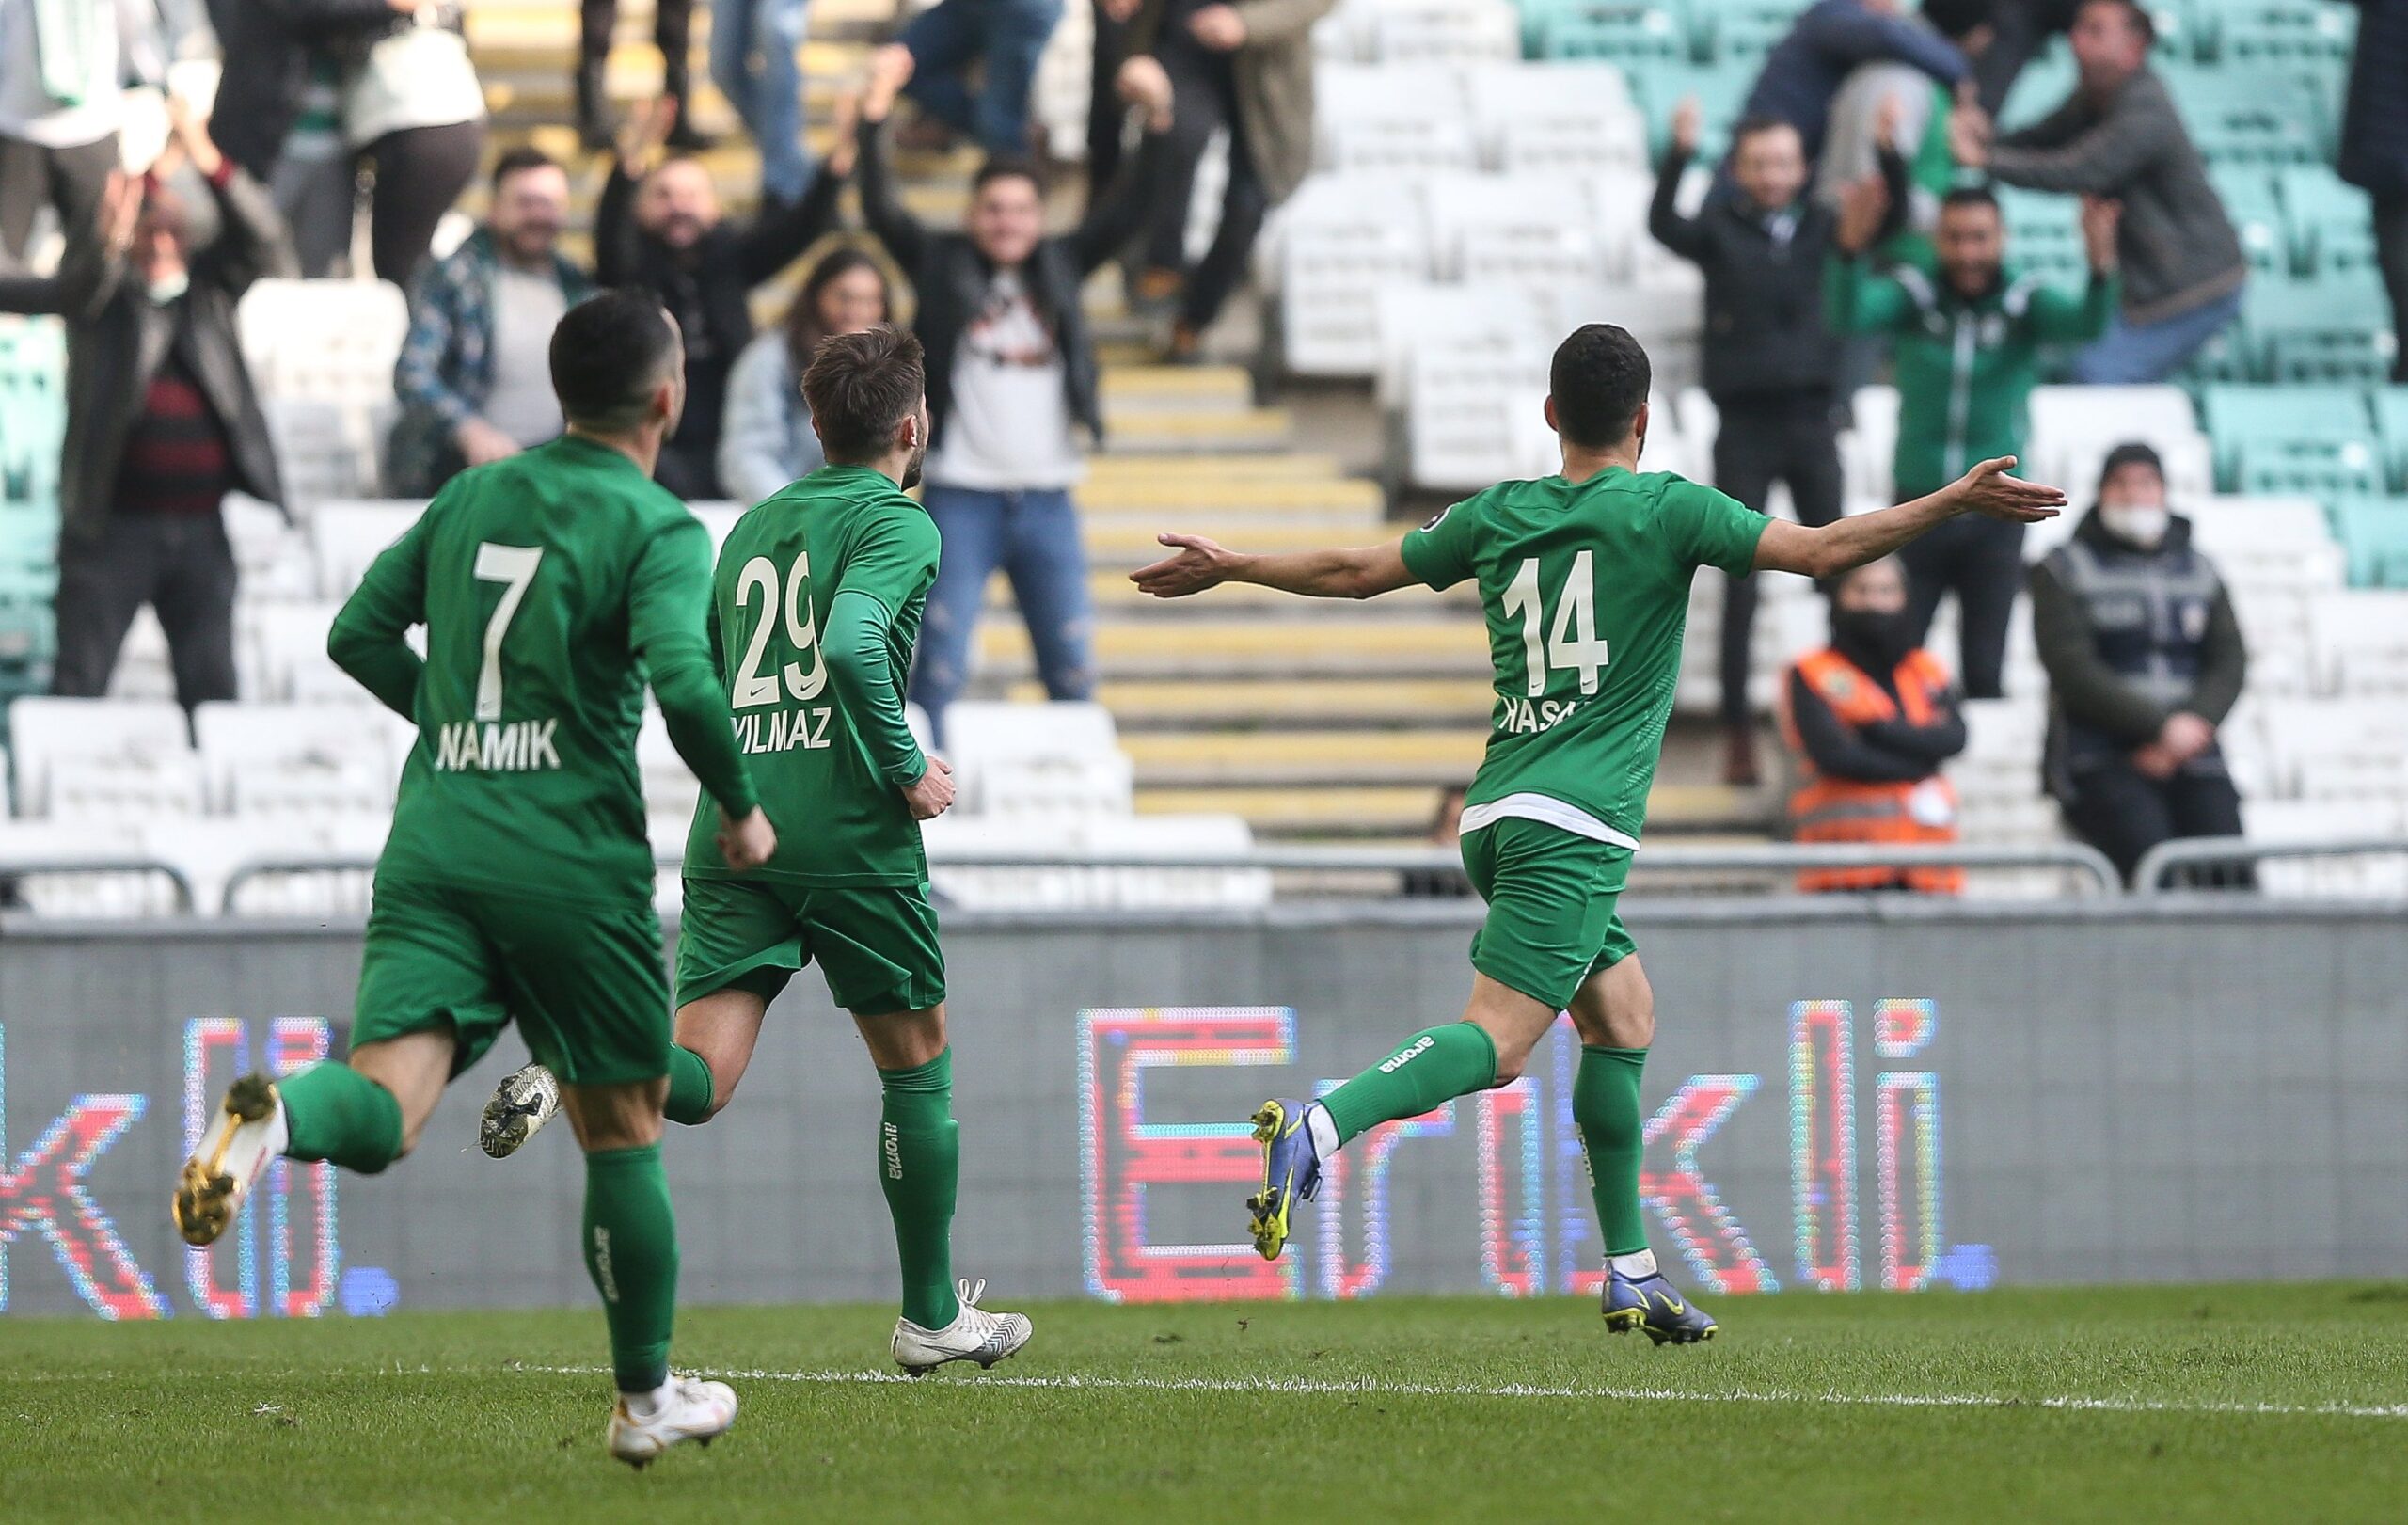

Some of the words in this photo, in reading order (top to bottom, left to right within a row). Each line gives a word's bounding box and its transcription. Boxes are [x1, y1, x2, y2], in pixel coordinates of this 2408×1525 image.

[473, 541, 544, 722] 7
[732, 550, 828, 709] 29
[1501, 549, 1609, 697] 14
[435, 717, 562, 771] NAMIK
[1378, 1036, 1435, 1073] aroma
[884, 1121, 903, 1180] aroma
